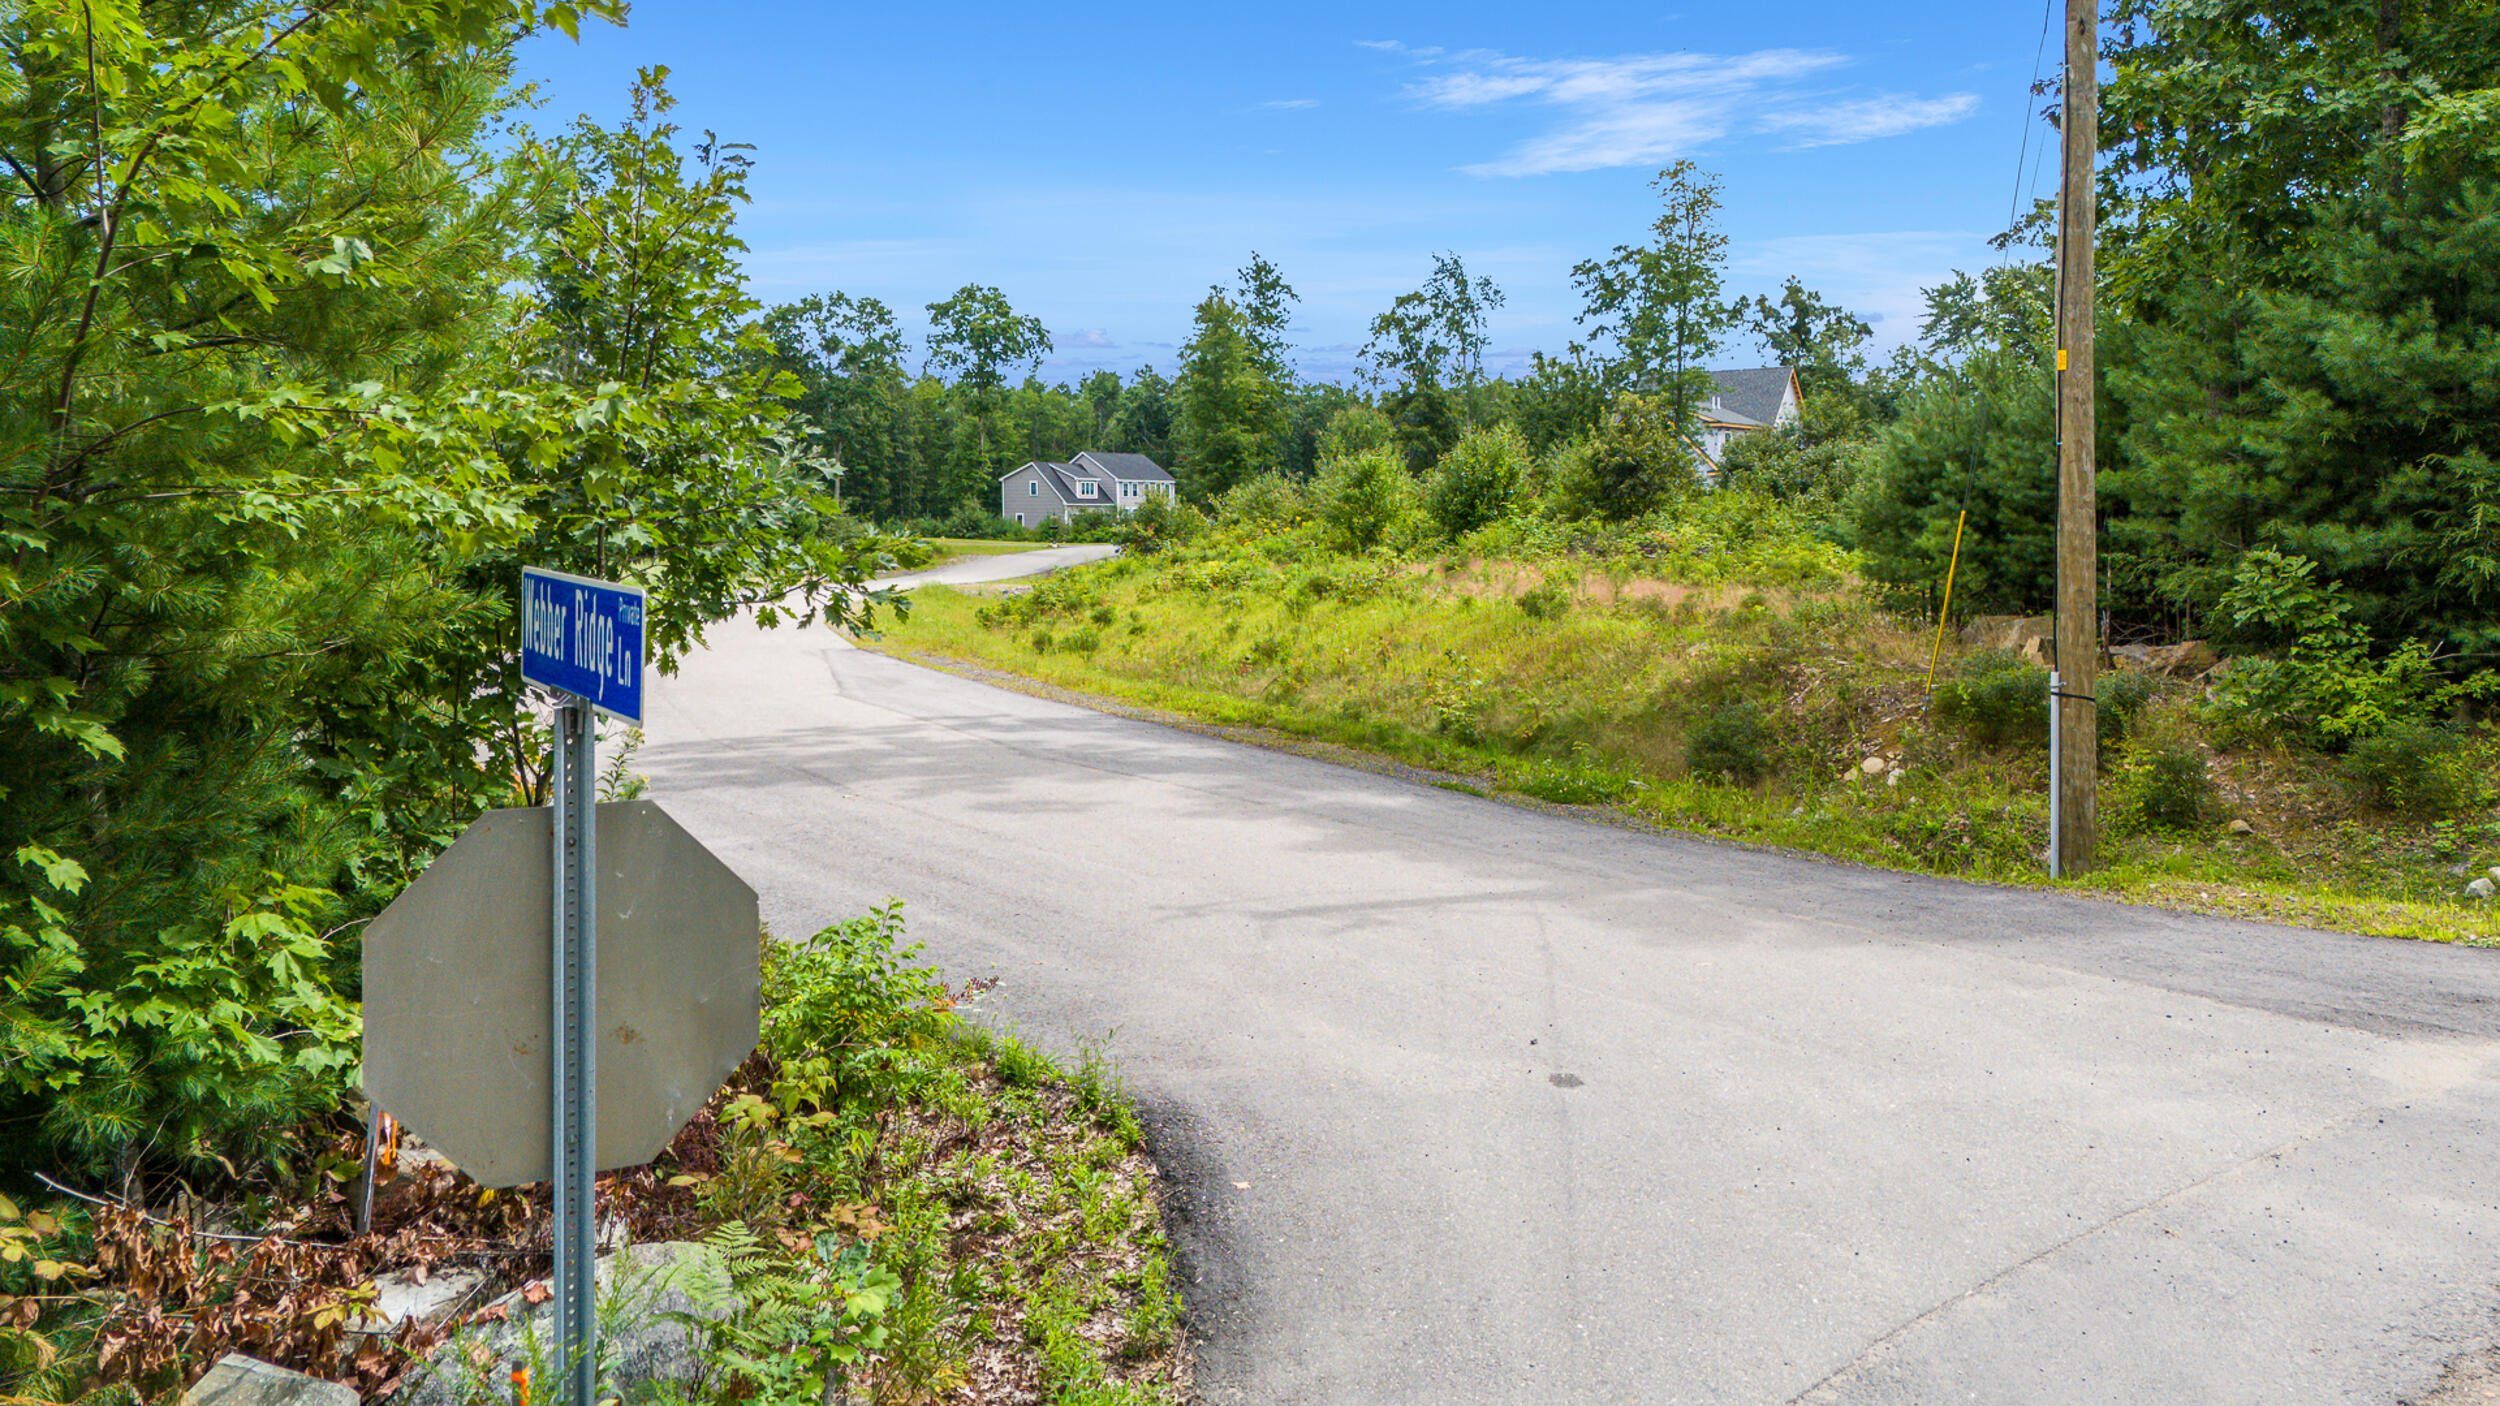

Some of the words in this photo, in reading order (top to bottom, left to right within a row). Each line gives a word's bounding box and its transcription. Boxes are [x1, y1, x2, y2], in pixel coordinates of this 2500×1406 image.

[525, 577, 567, 661] Webber
[574, 588, 614, 701] Ridge
[617, 635, 631, 688] Ln
[618, 596, 640, 626] Private
